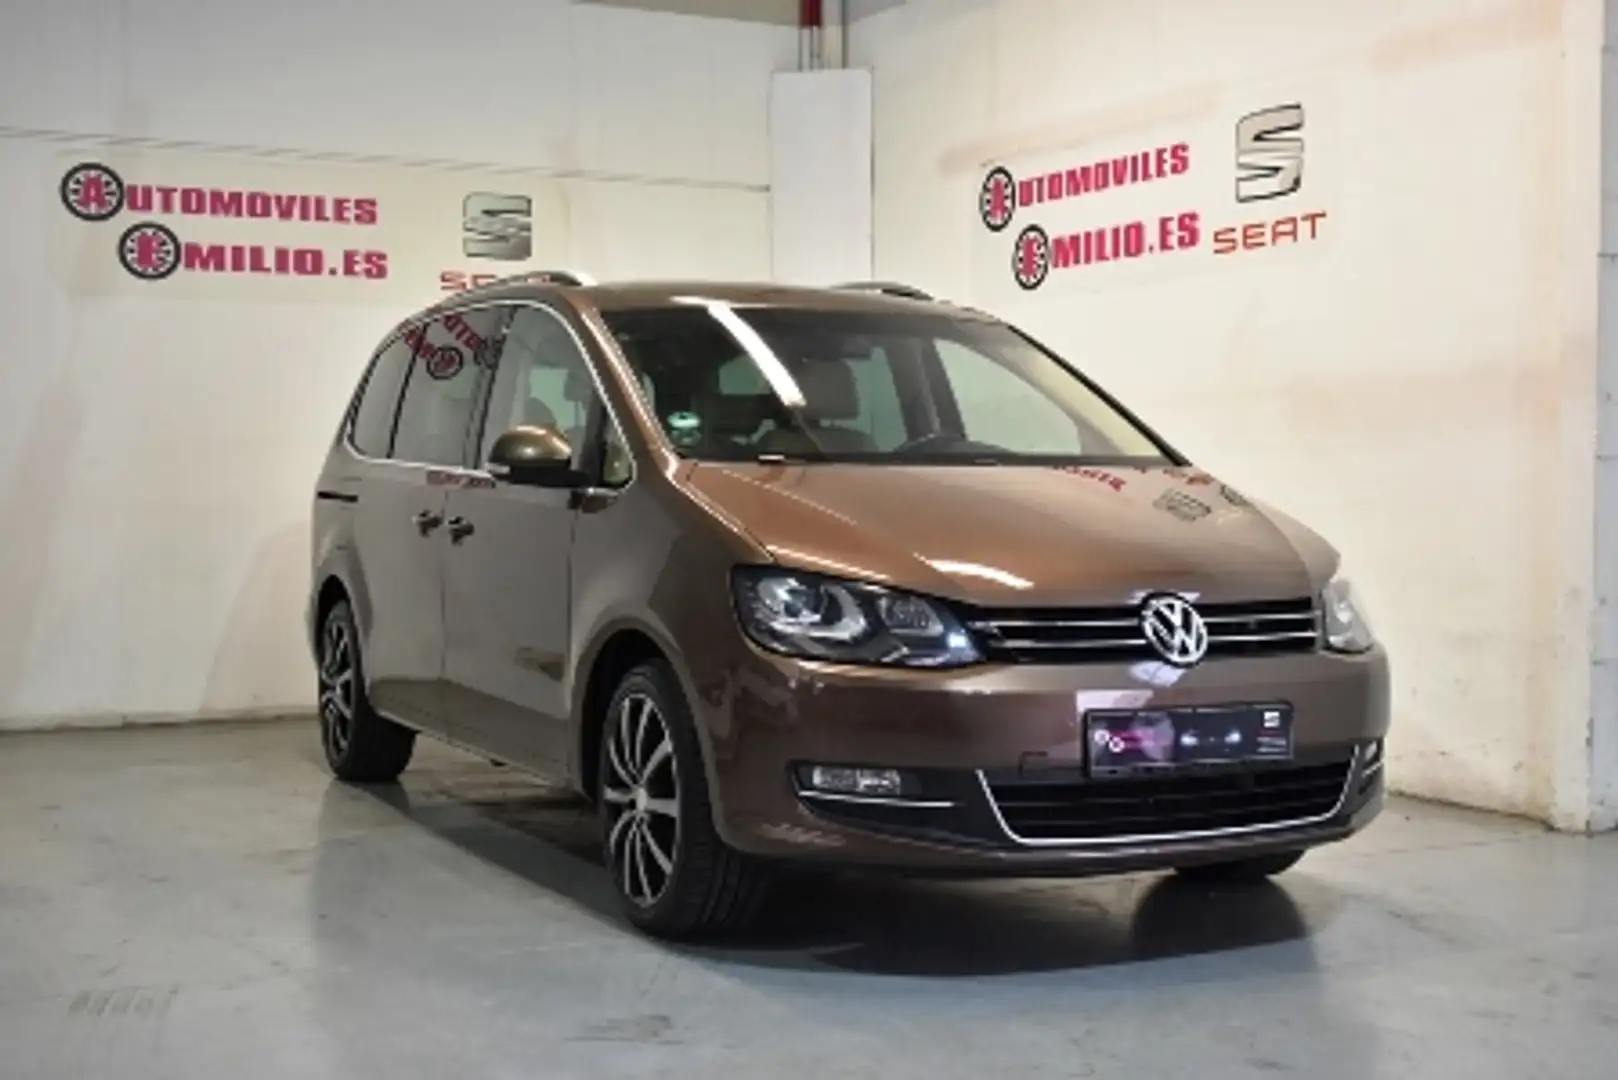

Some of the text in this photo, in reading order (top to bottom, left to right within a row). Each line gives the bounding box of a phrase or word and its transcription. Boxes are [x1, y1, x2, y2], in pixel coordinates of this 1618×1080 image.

[61, 162, 379, 225] AUTOMOVILES
[979, 142, 1190, 232] AUTOMOVILES
[1213, 211, 1327, 254] SEAT
